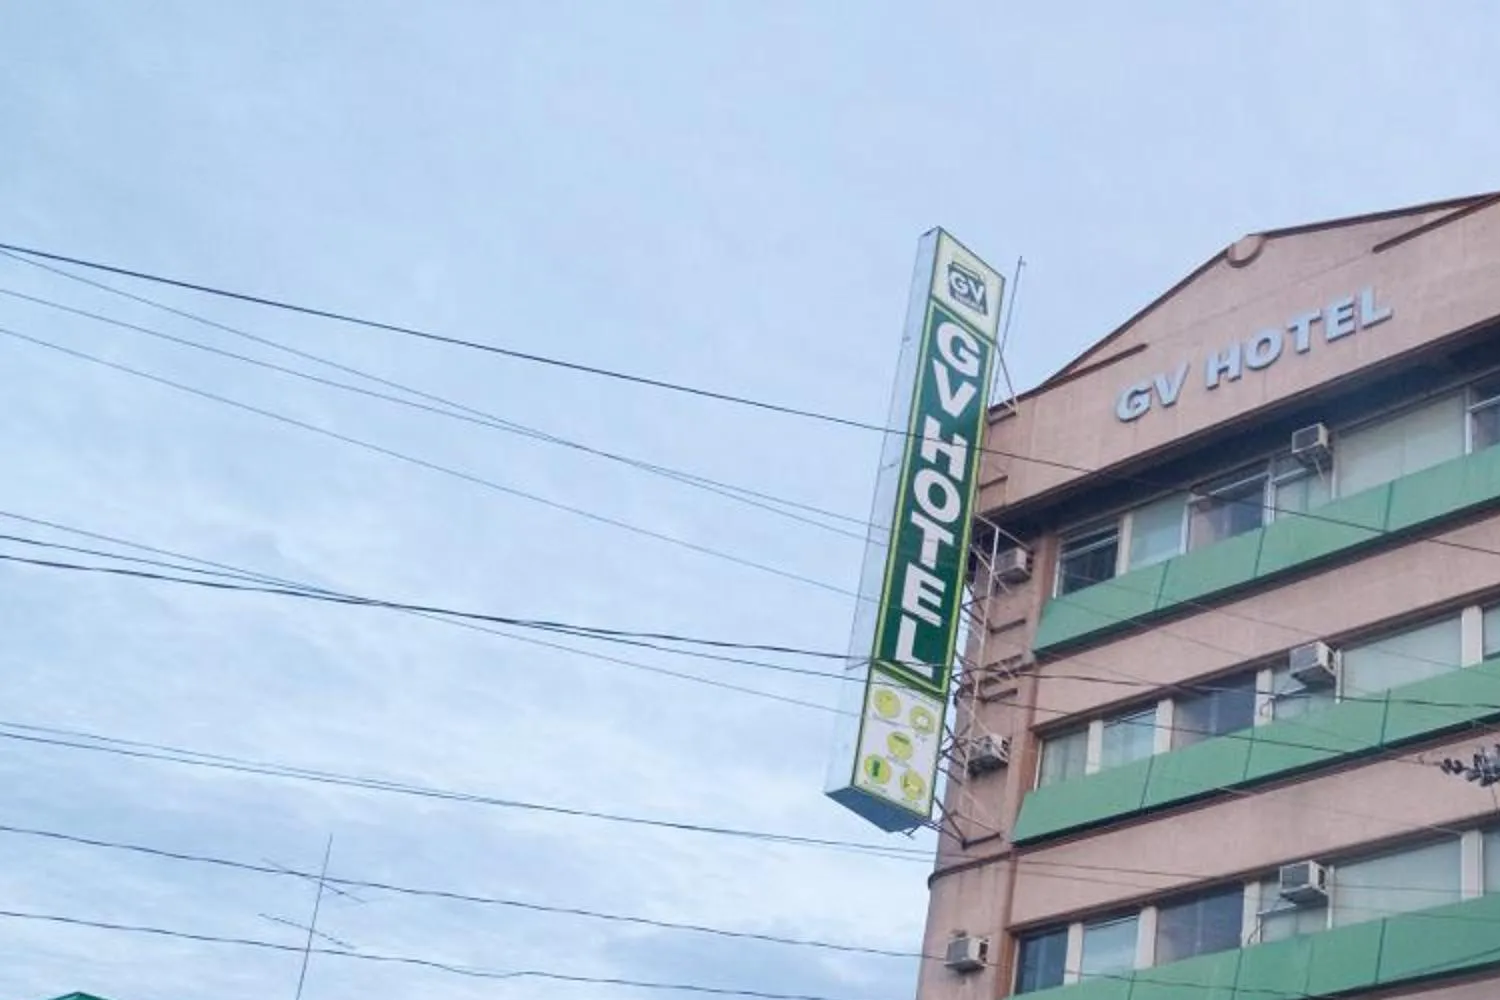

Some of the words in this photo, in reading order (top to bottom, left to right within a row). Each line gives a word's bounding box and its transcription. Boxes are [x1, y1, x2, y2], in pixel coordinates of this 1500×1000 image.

[951, 271, 984, 303] GV
[932, 321, 981, 418] GV
[1115, 360, 1190, 423] GV
[1205, 285, 1393, 390] HOTEL
[894, 417, 968, 687] HOTEL
